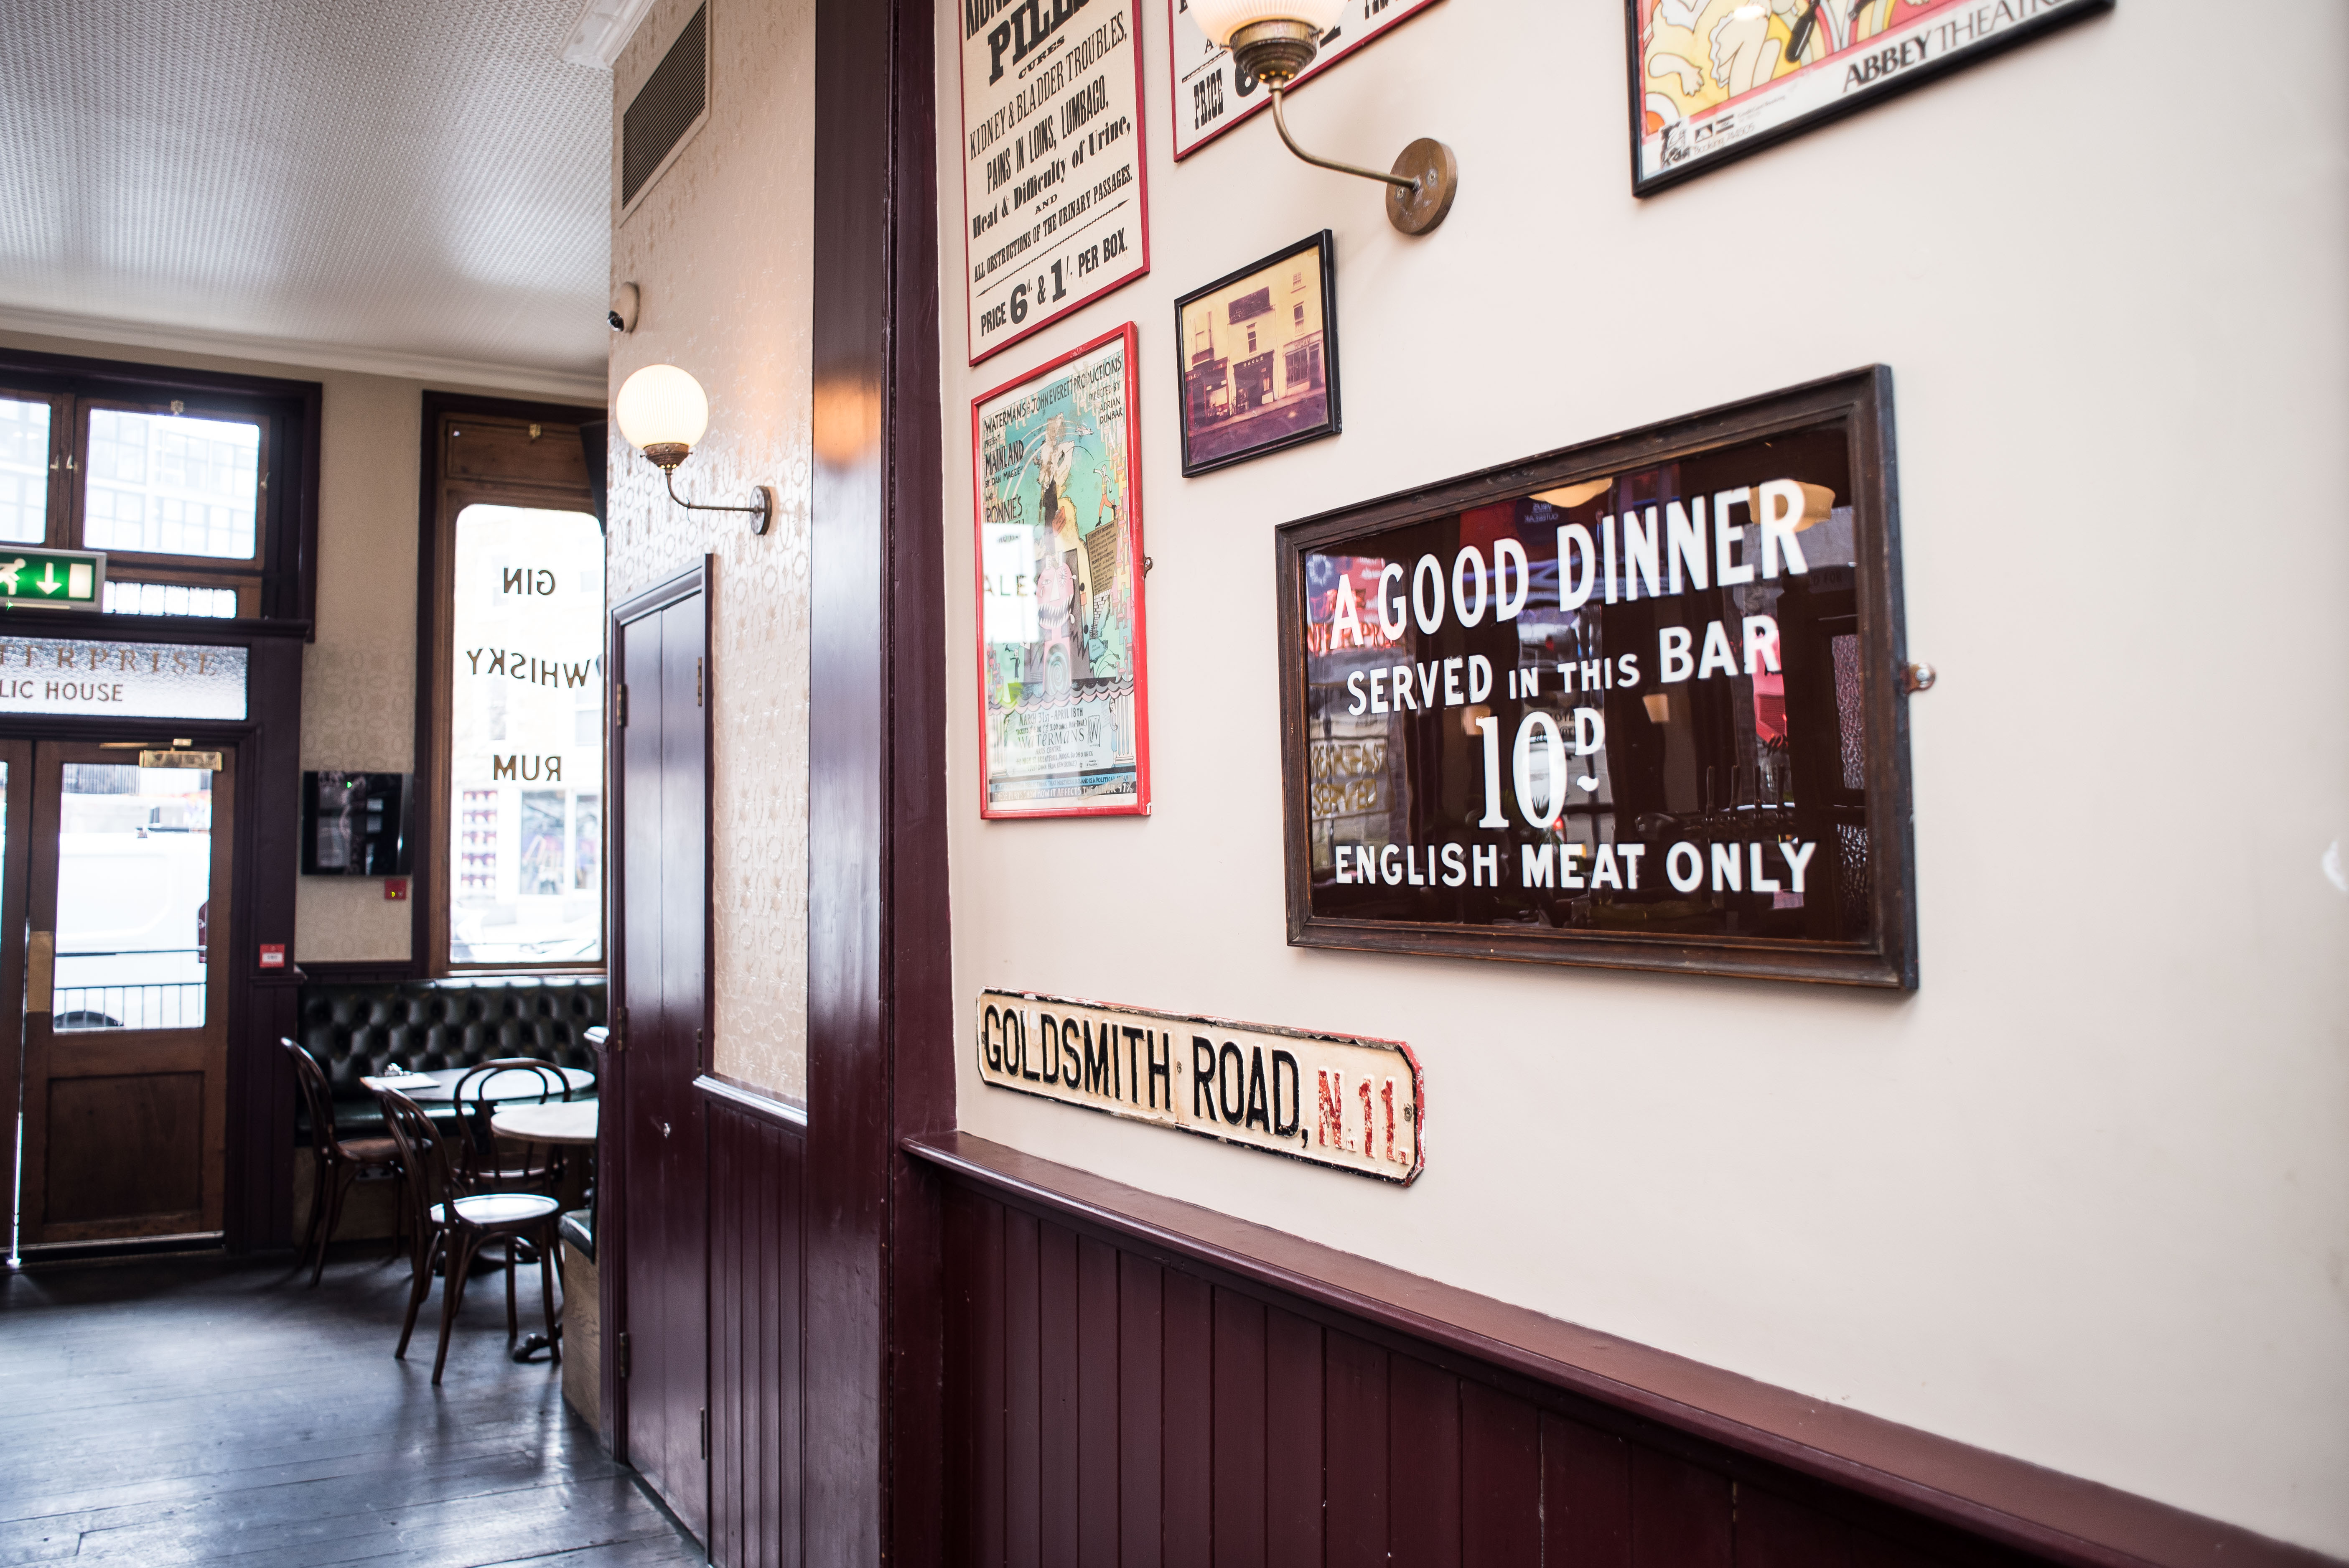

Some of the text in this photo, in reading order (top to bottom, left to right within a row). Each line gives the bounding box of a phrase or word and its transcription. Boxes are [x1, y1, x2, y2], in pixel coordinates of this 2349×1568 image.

[987, 0, 1089, 87] PILL
[1018, 35, 1065, 79] CURES
[1842, 30, 1931, 93] ABBEY
[970, 10, 1127, 160] KIDNEY & BLADDER TROUBLES,
[1194, 68, 1223, 130] PRICE
[987, 75, 1109, 195] PAINS IN LOINS, LUMBAGO,
[972, 116, 1130, 239] Heat & Difficulty of Urine,
[1035, 193, 1057, 215] AND
[974, 164, 1133, 283] ALL OBSTRUCTIONS OF THE URINARY PASSAGES.
[981, 301, 1007, 337] PRICE
[1037, 275, 1046, 305] &
[1078, 244, 1099, 278] PER
[1103, 227, 1128, 264] BOX.
[985, 402, 1026, 433] WATERMANS
[1031, 391, 1049, 413] JOHN
[1049, 378, 1073, 405] EVERETT
[1074, 356, 1122, 393] PROUCTIONS
[1100, 396, 1120, 413] ADRIAN
[1114, 380, 1120, 392] BY
[985, 434, 1000, 448] PRESENT
[1100, 407, 1123, 425] DUNBAR
[985, 440, 1024, 476] MAINLAND
[992, 475, 1001, 485] DAN
[1330, 478, 1808, 650] A GOOD DINNER
[46, 681, 123, 702] HOUSE
[1347, 614, 1781, 716] SERVED IN THIS BAR
[1020, 713, 1036, 725] MARCH
[1054, 709, 1069, 720] APRIL
[1071, 708, 1083, 718] 18TH
[1037, 789, 1050, 798] HOW
[1051, 788, 1056, 797] IT
[1057, 787, 1082, 796] AFFECTS
[1337, 841, 1817, 893] ENGLISH MEAT ONLY
[984, 1004, 1171, 1112] GOLDSMITH
[1192, 1035, 1309, 1150] ROAD,
